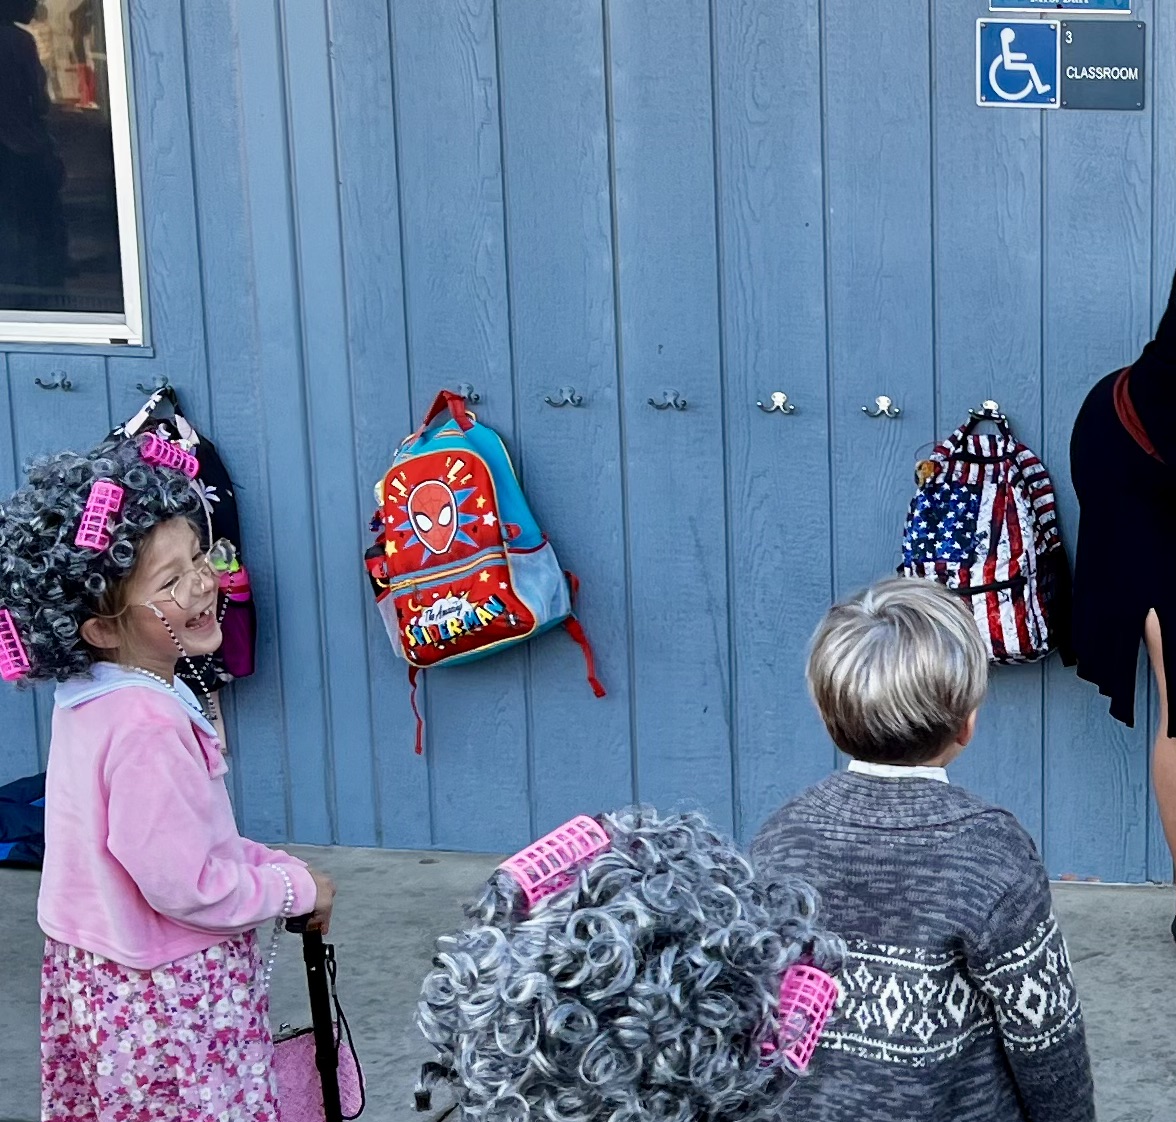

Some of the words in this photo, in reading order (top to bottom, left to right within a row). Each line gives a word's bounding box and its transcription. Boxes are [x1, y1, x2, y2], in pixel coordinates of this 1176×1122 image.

[1065, 30, 1073, 44] 3
[1066, 66, 1139, 81] CLASSROOM
[424, 608, 435, 622] The
